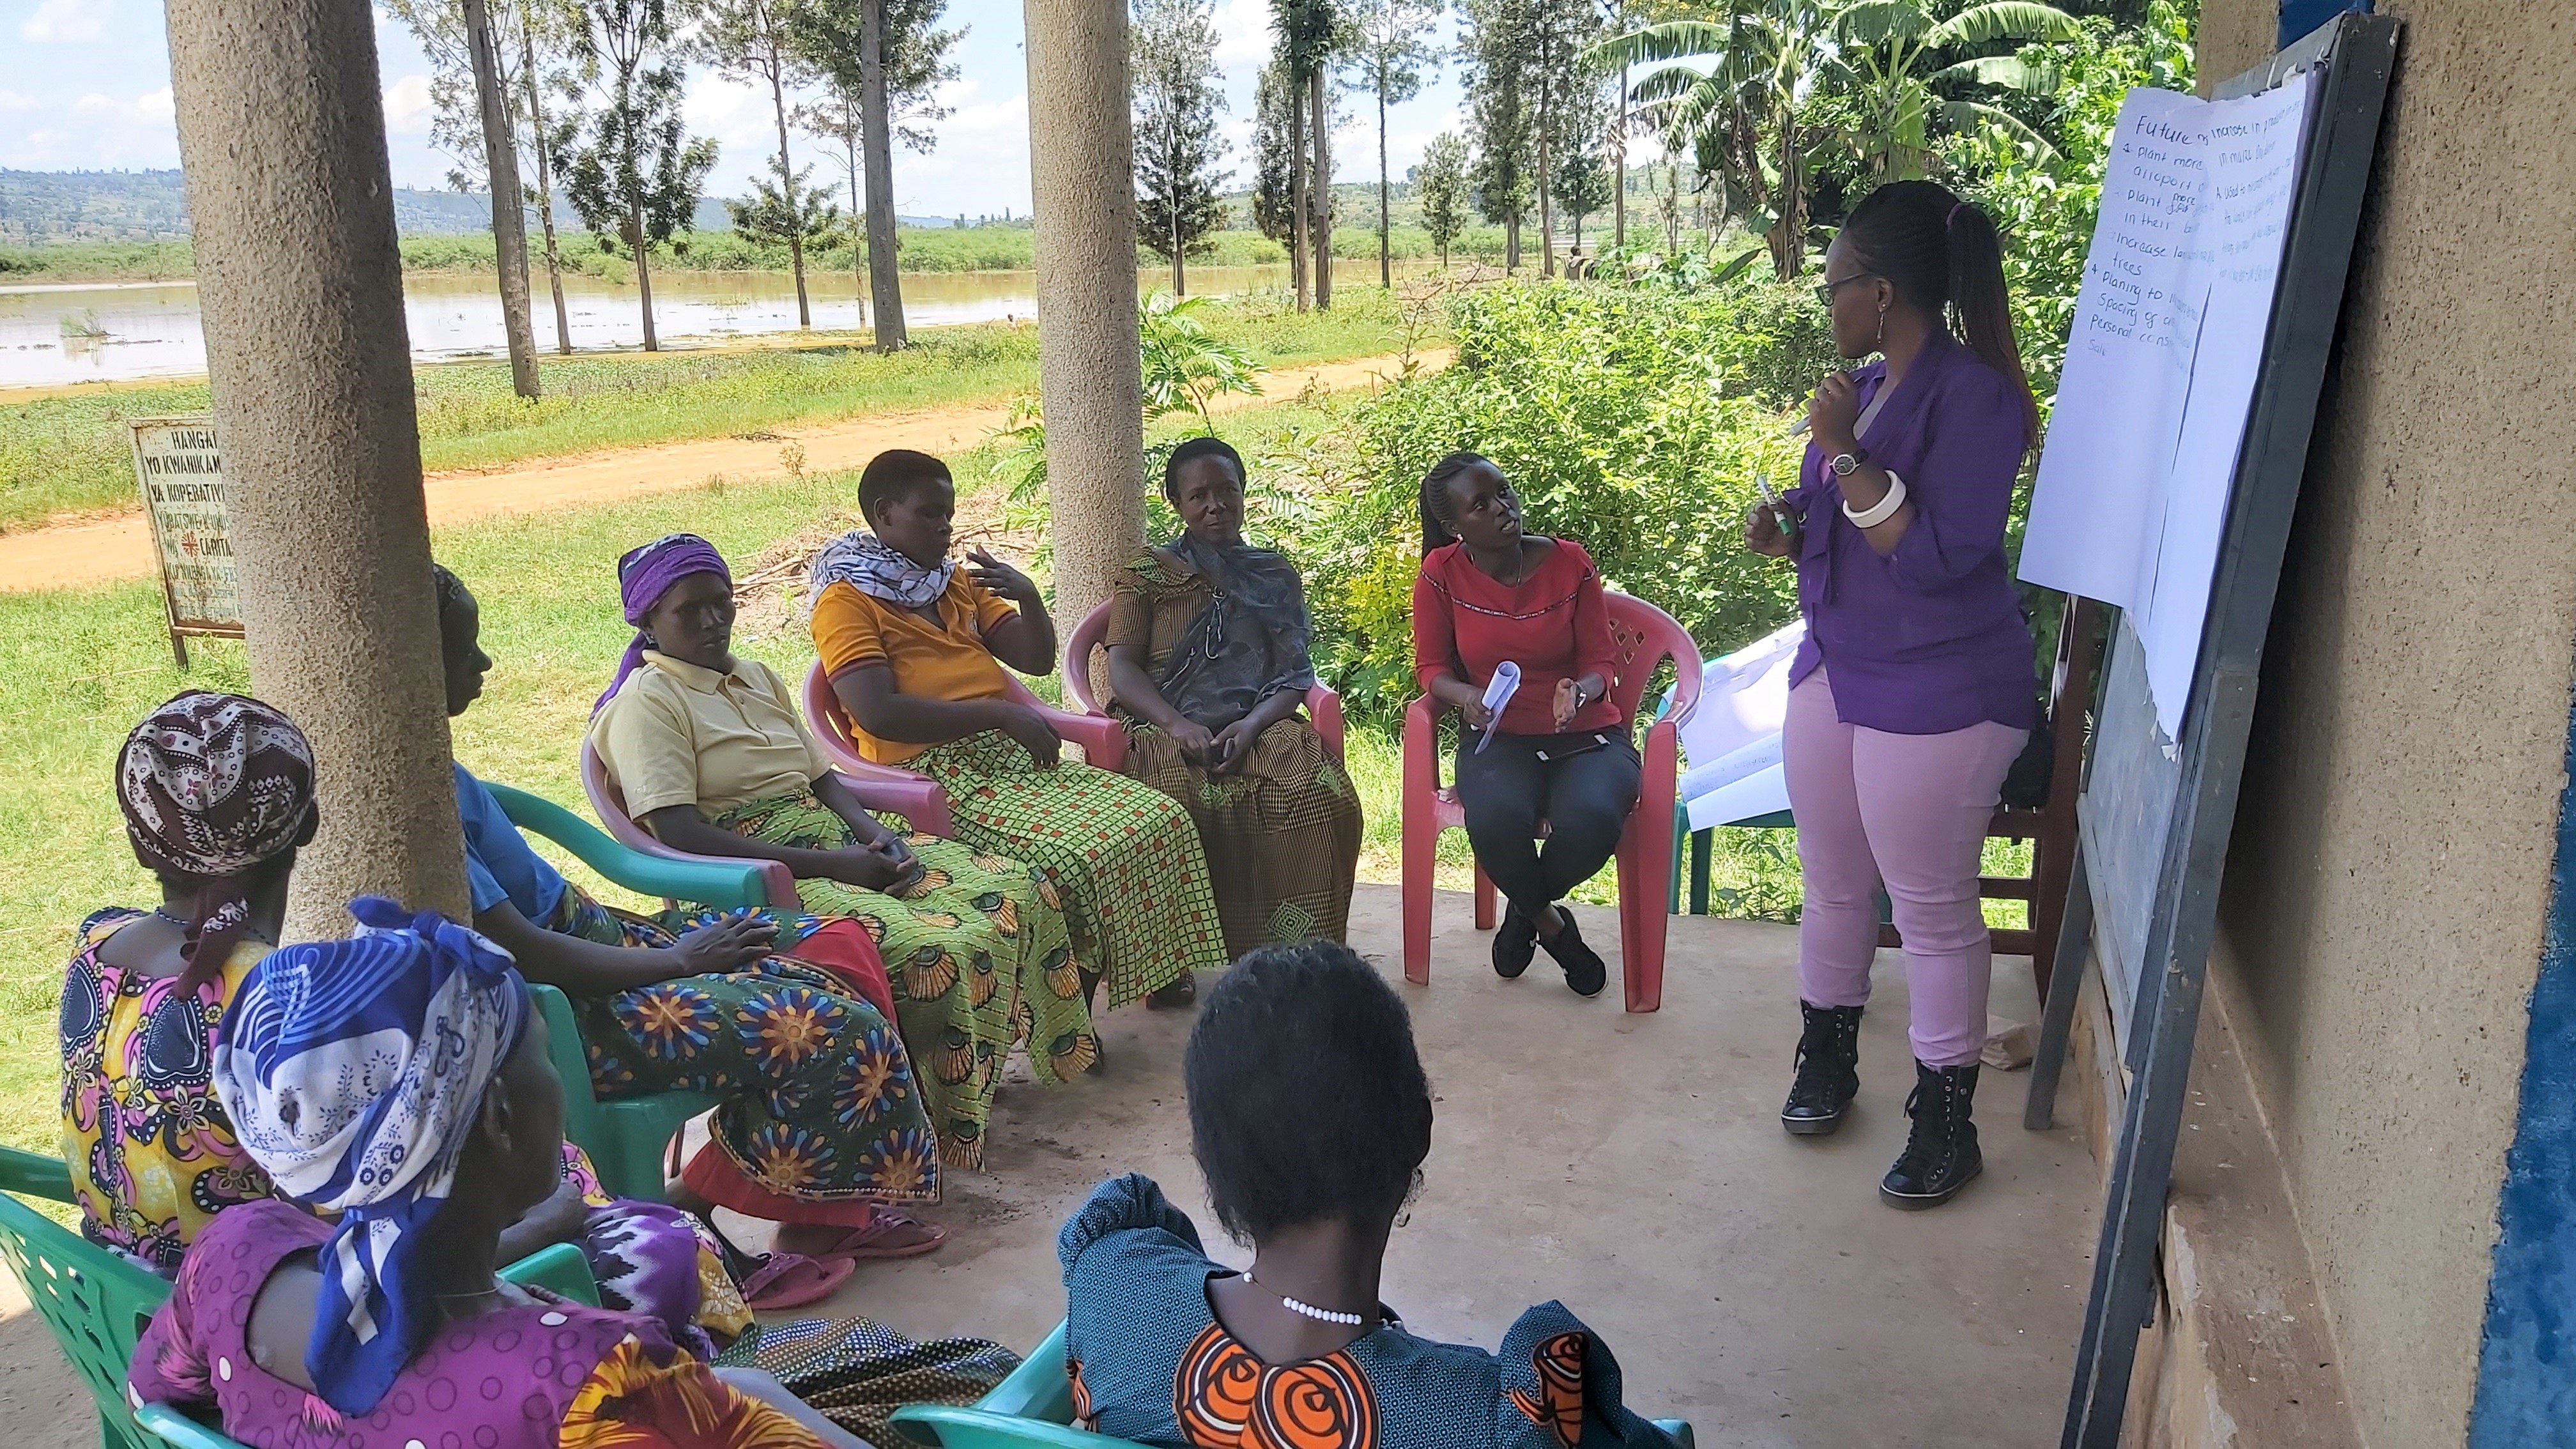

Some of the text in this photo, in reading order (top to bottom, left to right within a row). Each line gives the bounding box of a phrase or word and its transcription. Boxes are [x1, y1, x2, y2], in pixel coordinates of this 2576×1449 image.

[2135, 115, 2193, 145] Future
[2112, 251, 2142, 276] trees
[2147, 288, 2163, 300] to
[171, 430, 218, 450] HANGA
[144, 456, 160, 475] YO
[150, 484, 226, 503] YA KOPERATIV
